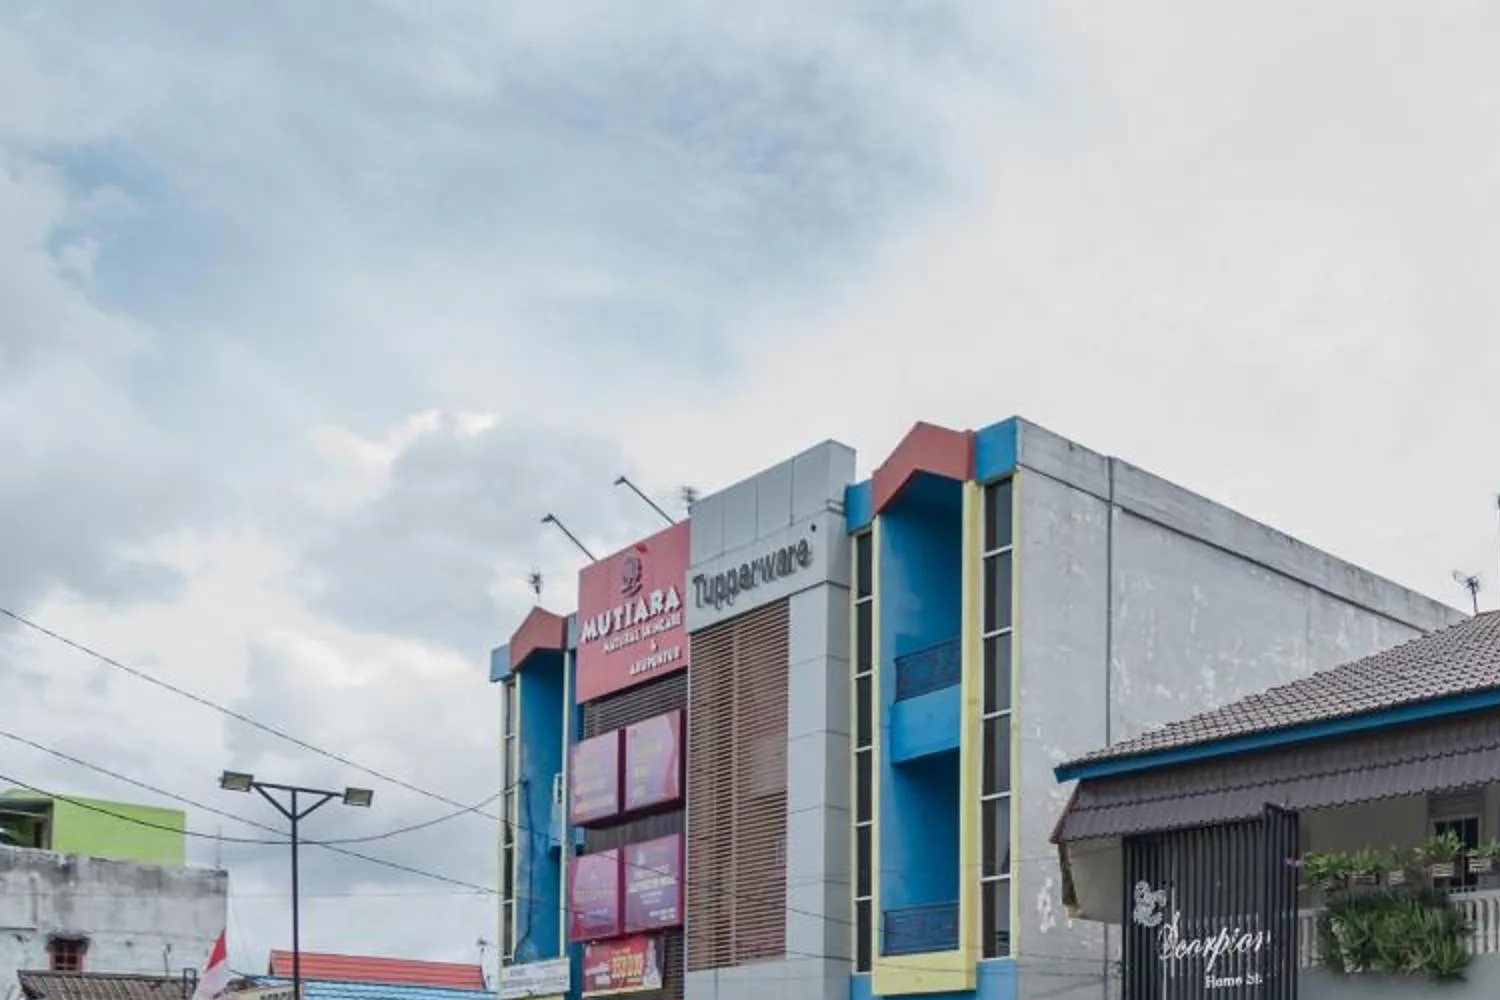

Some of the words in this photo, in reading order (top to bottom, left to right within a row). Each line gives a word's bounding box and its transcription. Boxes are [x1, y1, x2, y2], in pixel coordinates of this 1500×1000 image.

[692, 538, 809, 609] Tupperware
[581, 585, 681, 643] MUTIARA
[1204, 975, 1243, 989] Home
